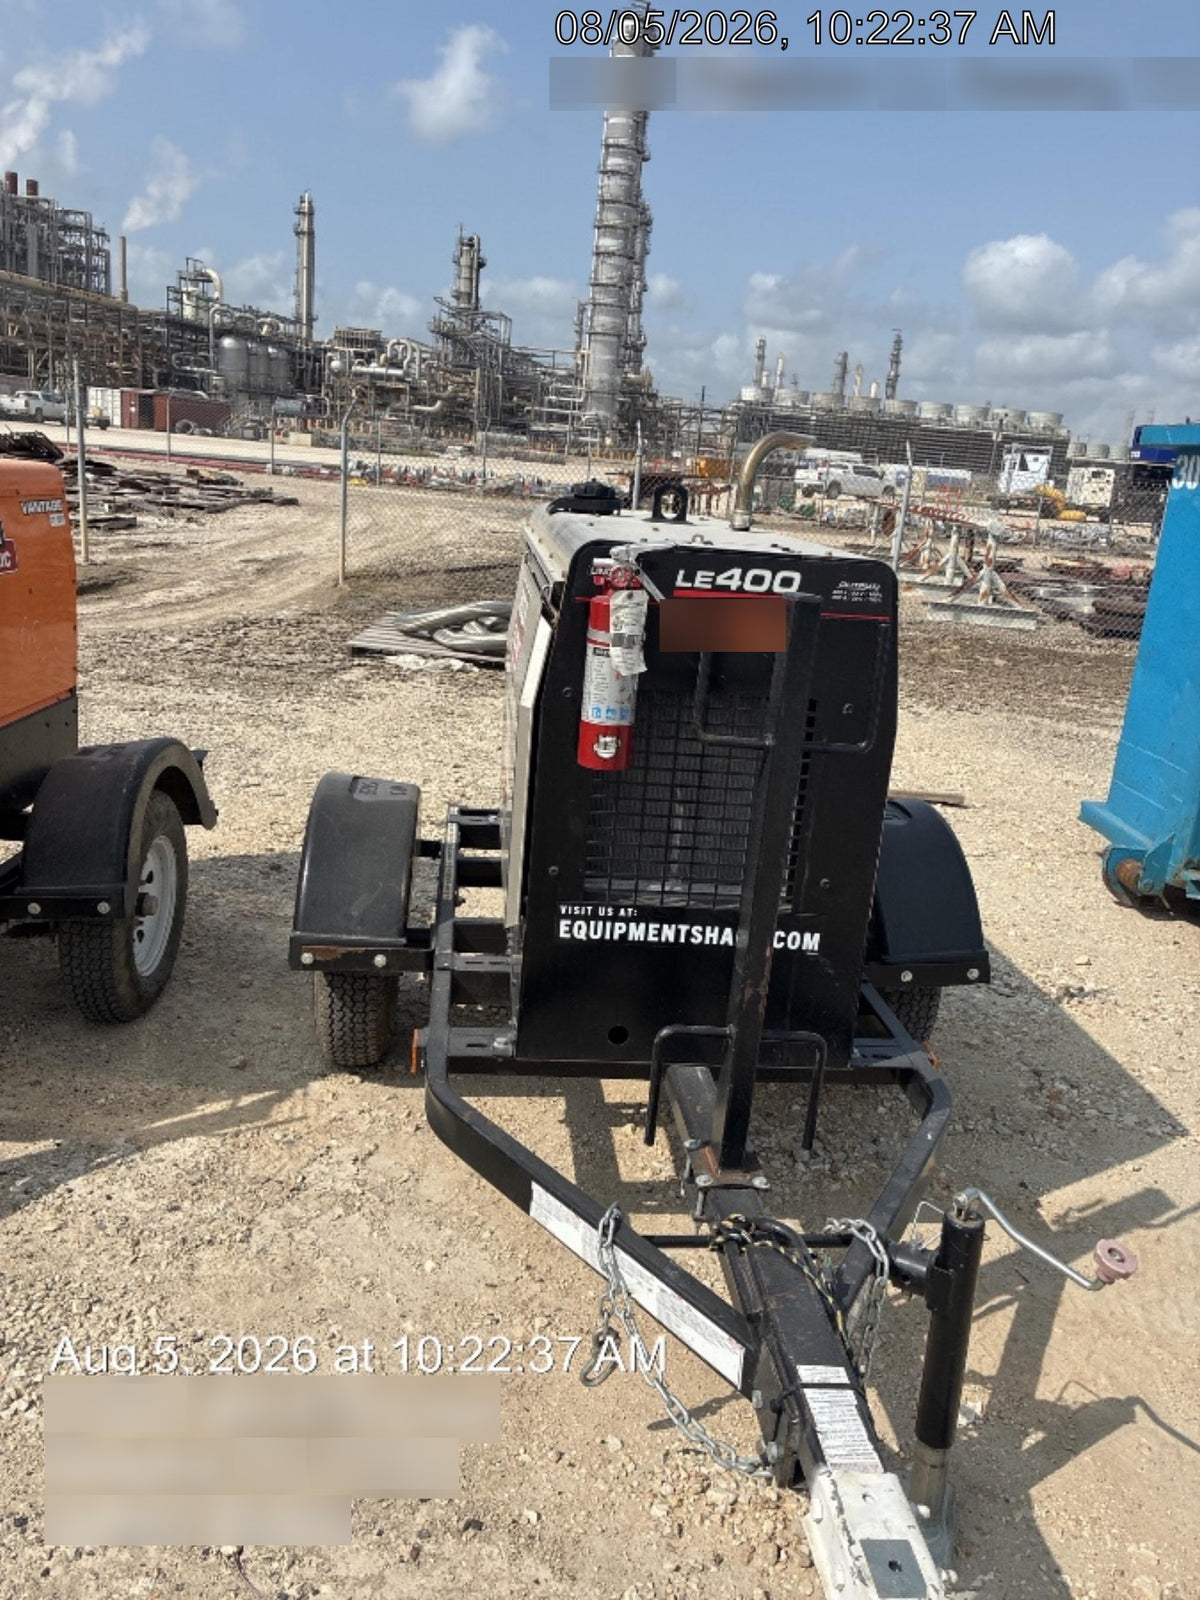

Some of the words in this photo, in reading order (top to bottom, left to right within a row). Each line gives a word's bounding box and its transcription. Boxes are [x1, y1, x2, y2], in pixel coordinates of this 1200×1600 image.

[675, 567, 801, 593] LE400
[559, 905, 592, 915] VISIT
[598, 906, 614, 916] US
[619, 907, 637, 917] AT:
[559, 920, 821, 951] EQUIPMENTSHACOM
